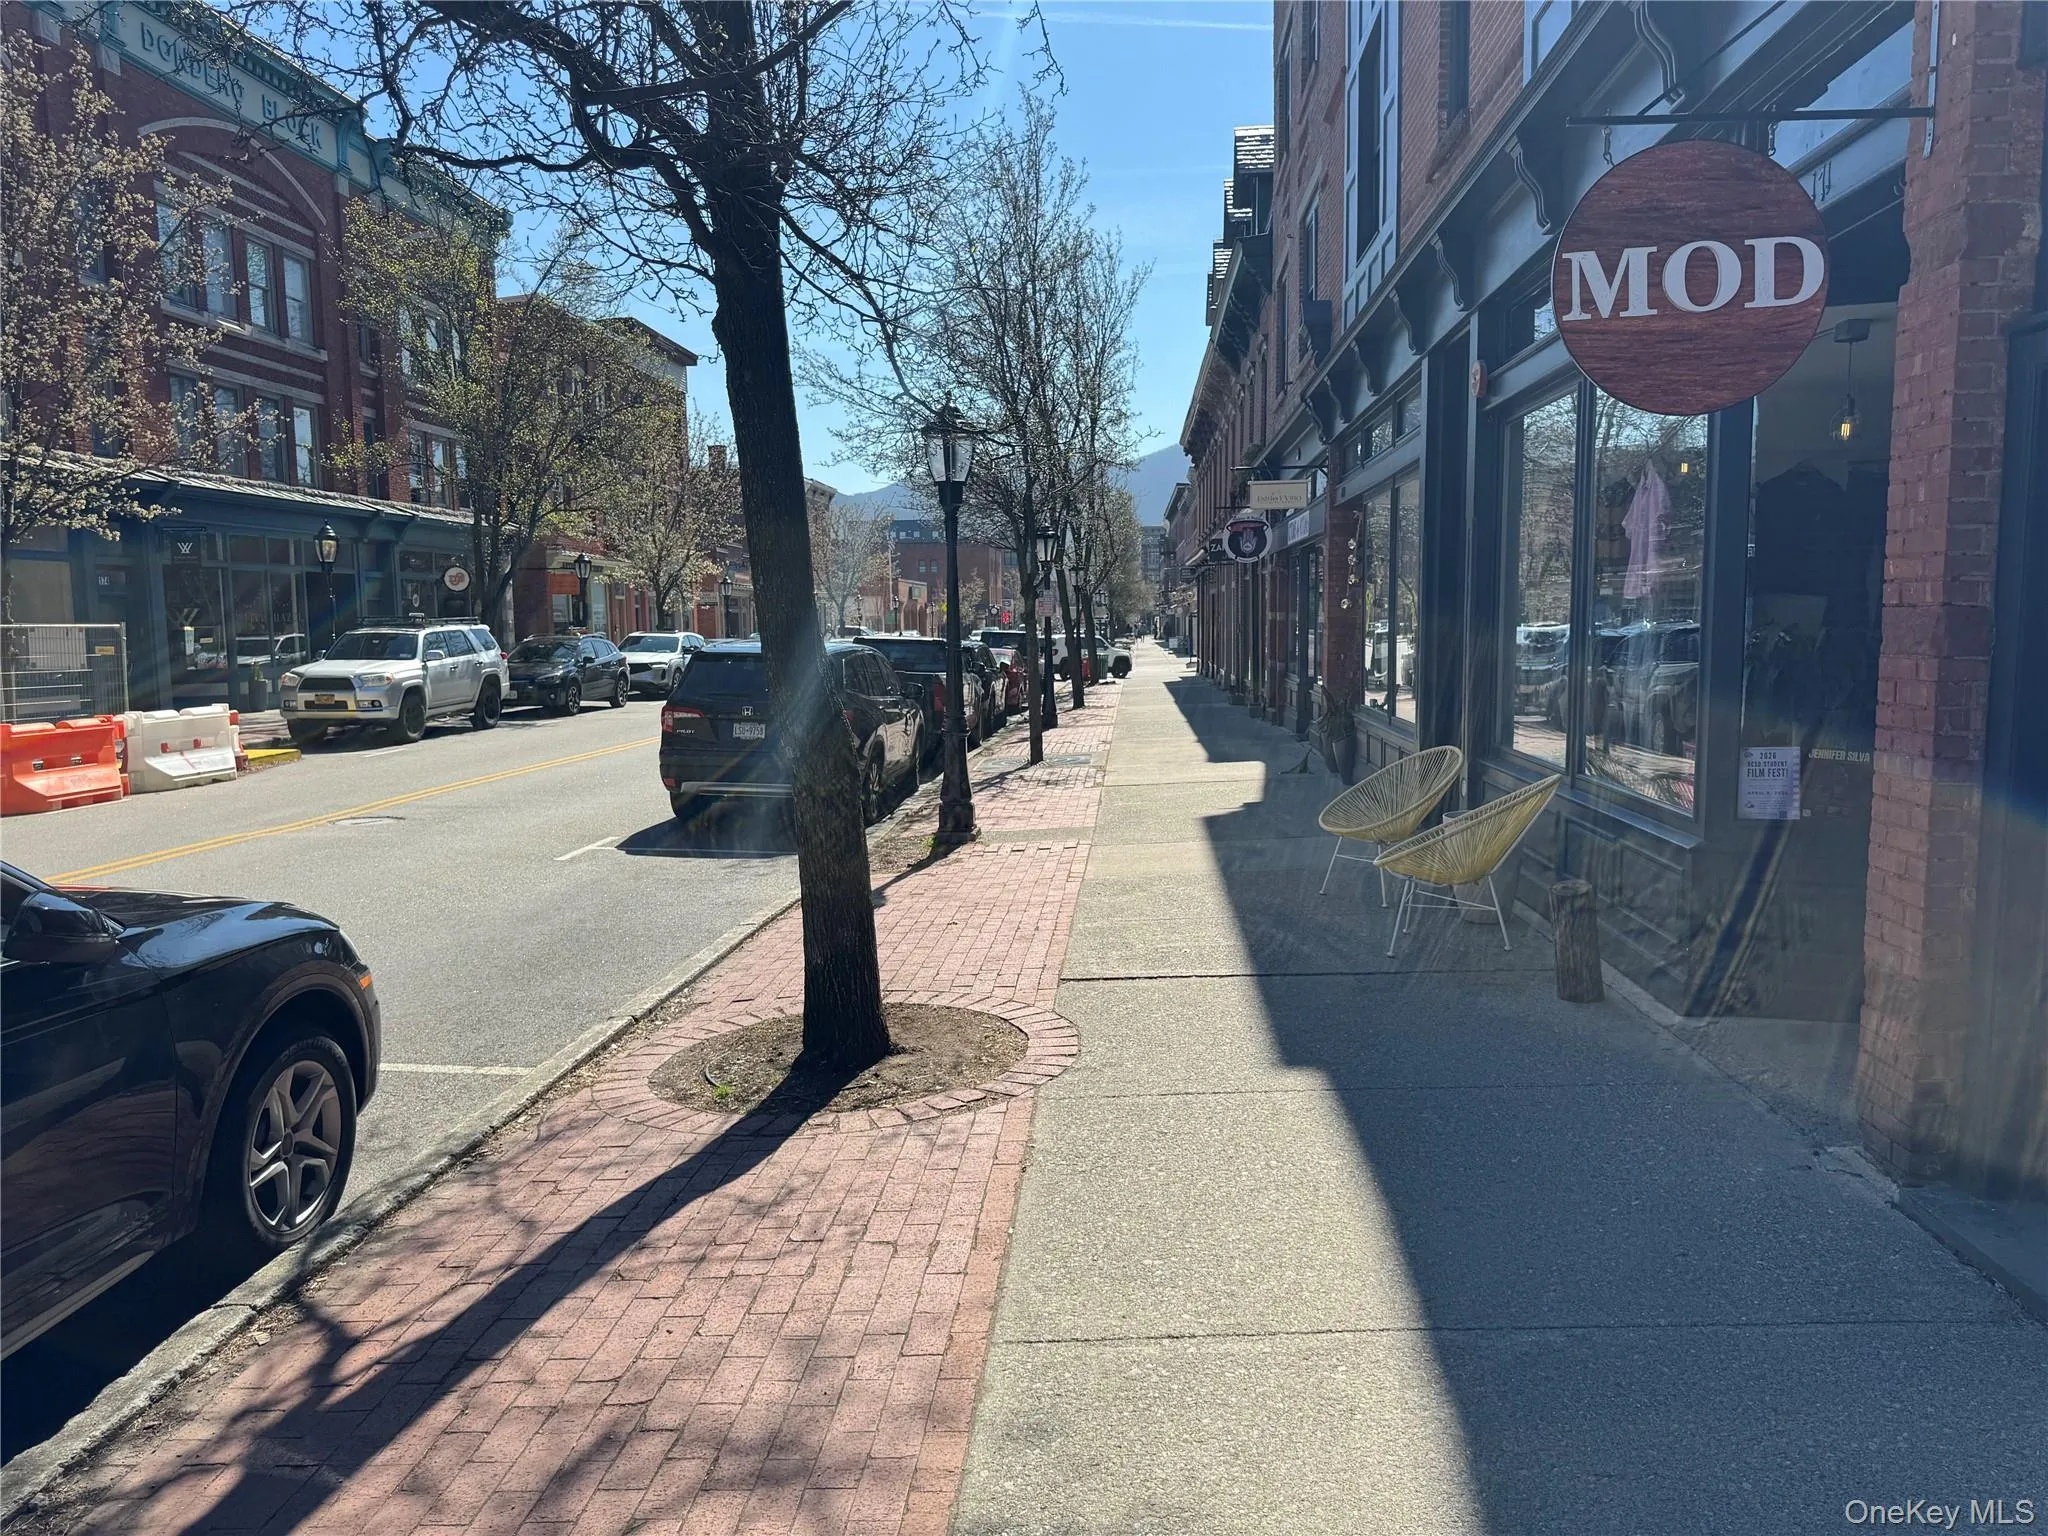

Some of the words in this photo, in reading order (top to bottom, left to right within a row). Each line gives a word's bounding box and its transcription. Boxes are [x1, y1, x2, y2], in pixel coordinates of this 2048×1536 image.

[262, 94, 322, 149] BLOCK
[1562, 236, 1825, 321] MOD
[1748, 768, 1764, 778] FILM
[1768, 768, 1788, 778] FEST!
[1808, 749, 1846, 760] JENNIFER
[1847, 752, 1870, 763] SILVA
